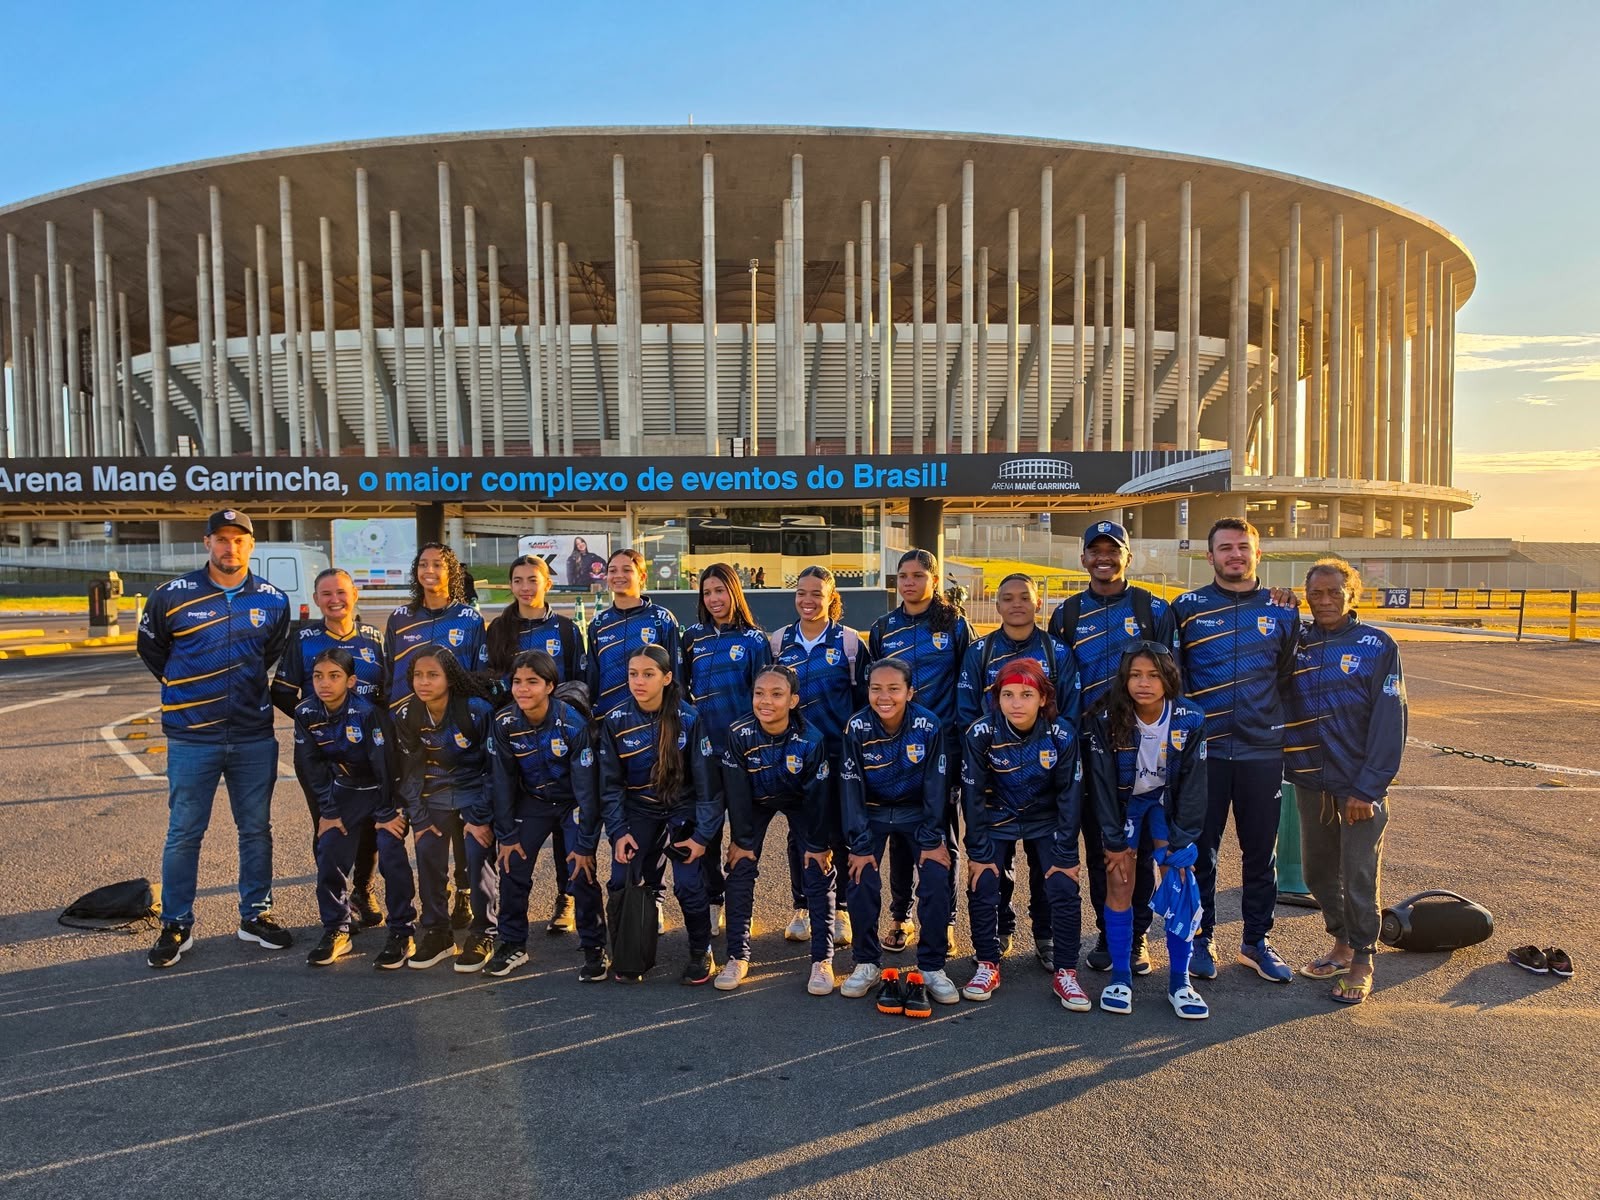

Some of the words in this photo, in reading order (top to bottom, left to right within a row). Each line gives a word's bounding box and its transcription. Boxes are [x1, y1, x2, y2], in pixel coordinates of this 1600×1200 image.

[0, 467, 83, 493] Arena
[93, 465, 176, 492] Mané
[186, 466, 348, 496] Garrincha,
[359, 472, 378, 492] o
[386, 467, 472, 492] maior
[482, 467, 628, 497] complexo
[637, 467, 674, 492] de
[682, 467, 798, 492] eventos
[807, 465, 844, 490] do
[854, 463, 947, 489] Brasil!
[991, 482, 1014, 490] ARENA
[1014, 481, 1036, 490] MANÉ
[1037, 482, 1080, 490] GARRINCHA
[1388, 594, 1407, 605] A6
